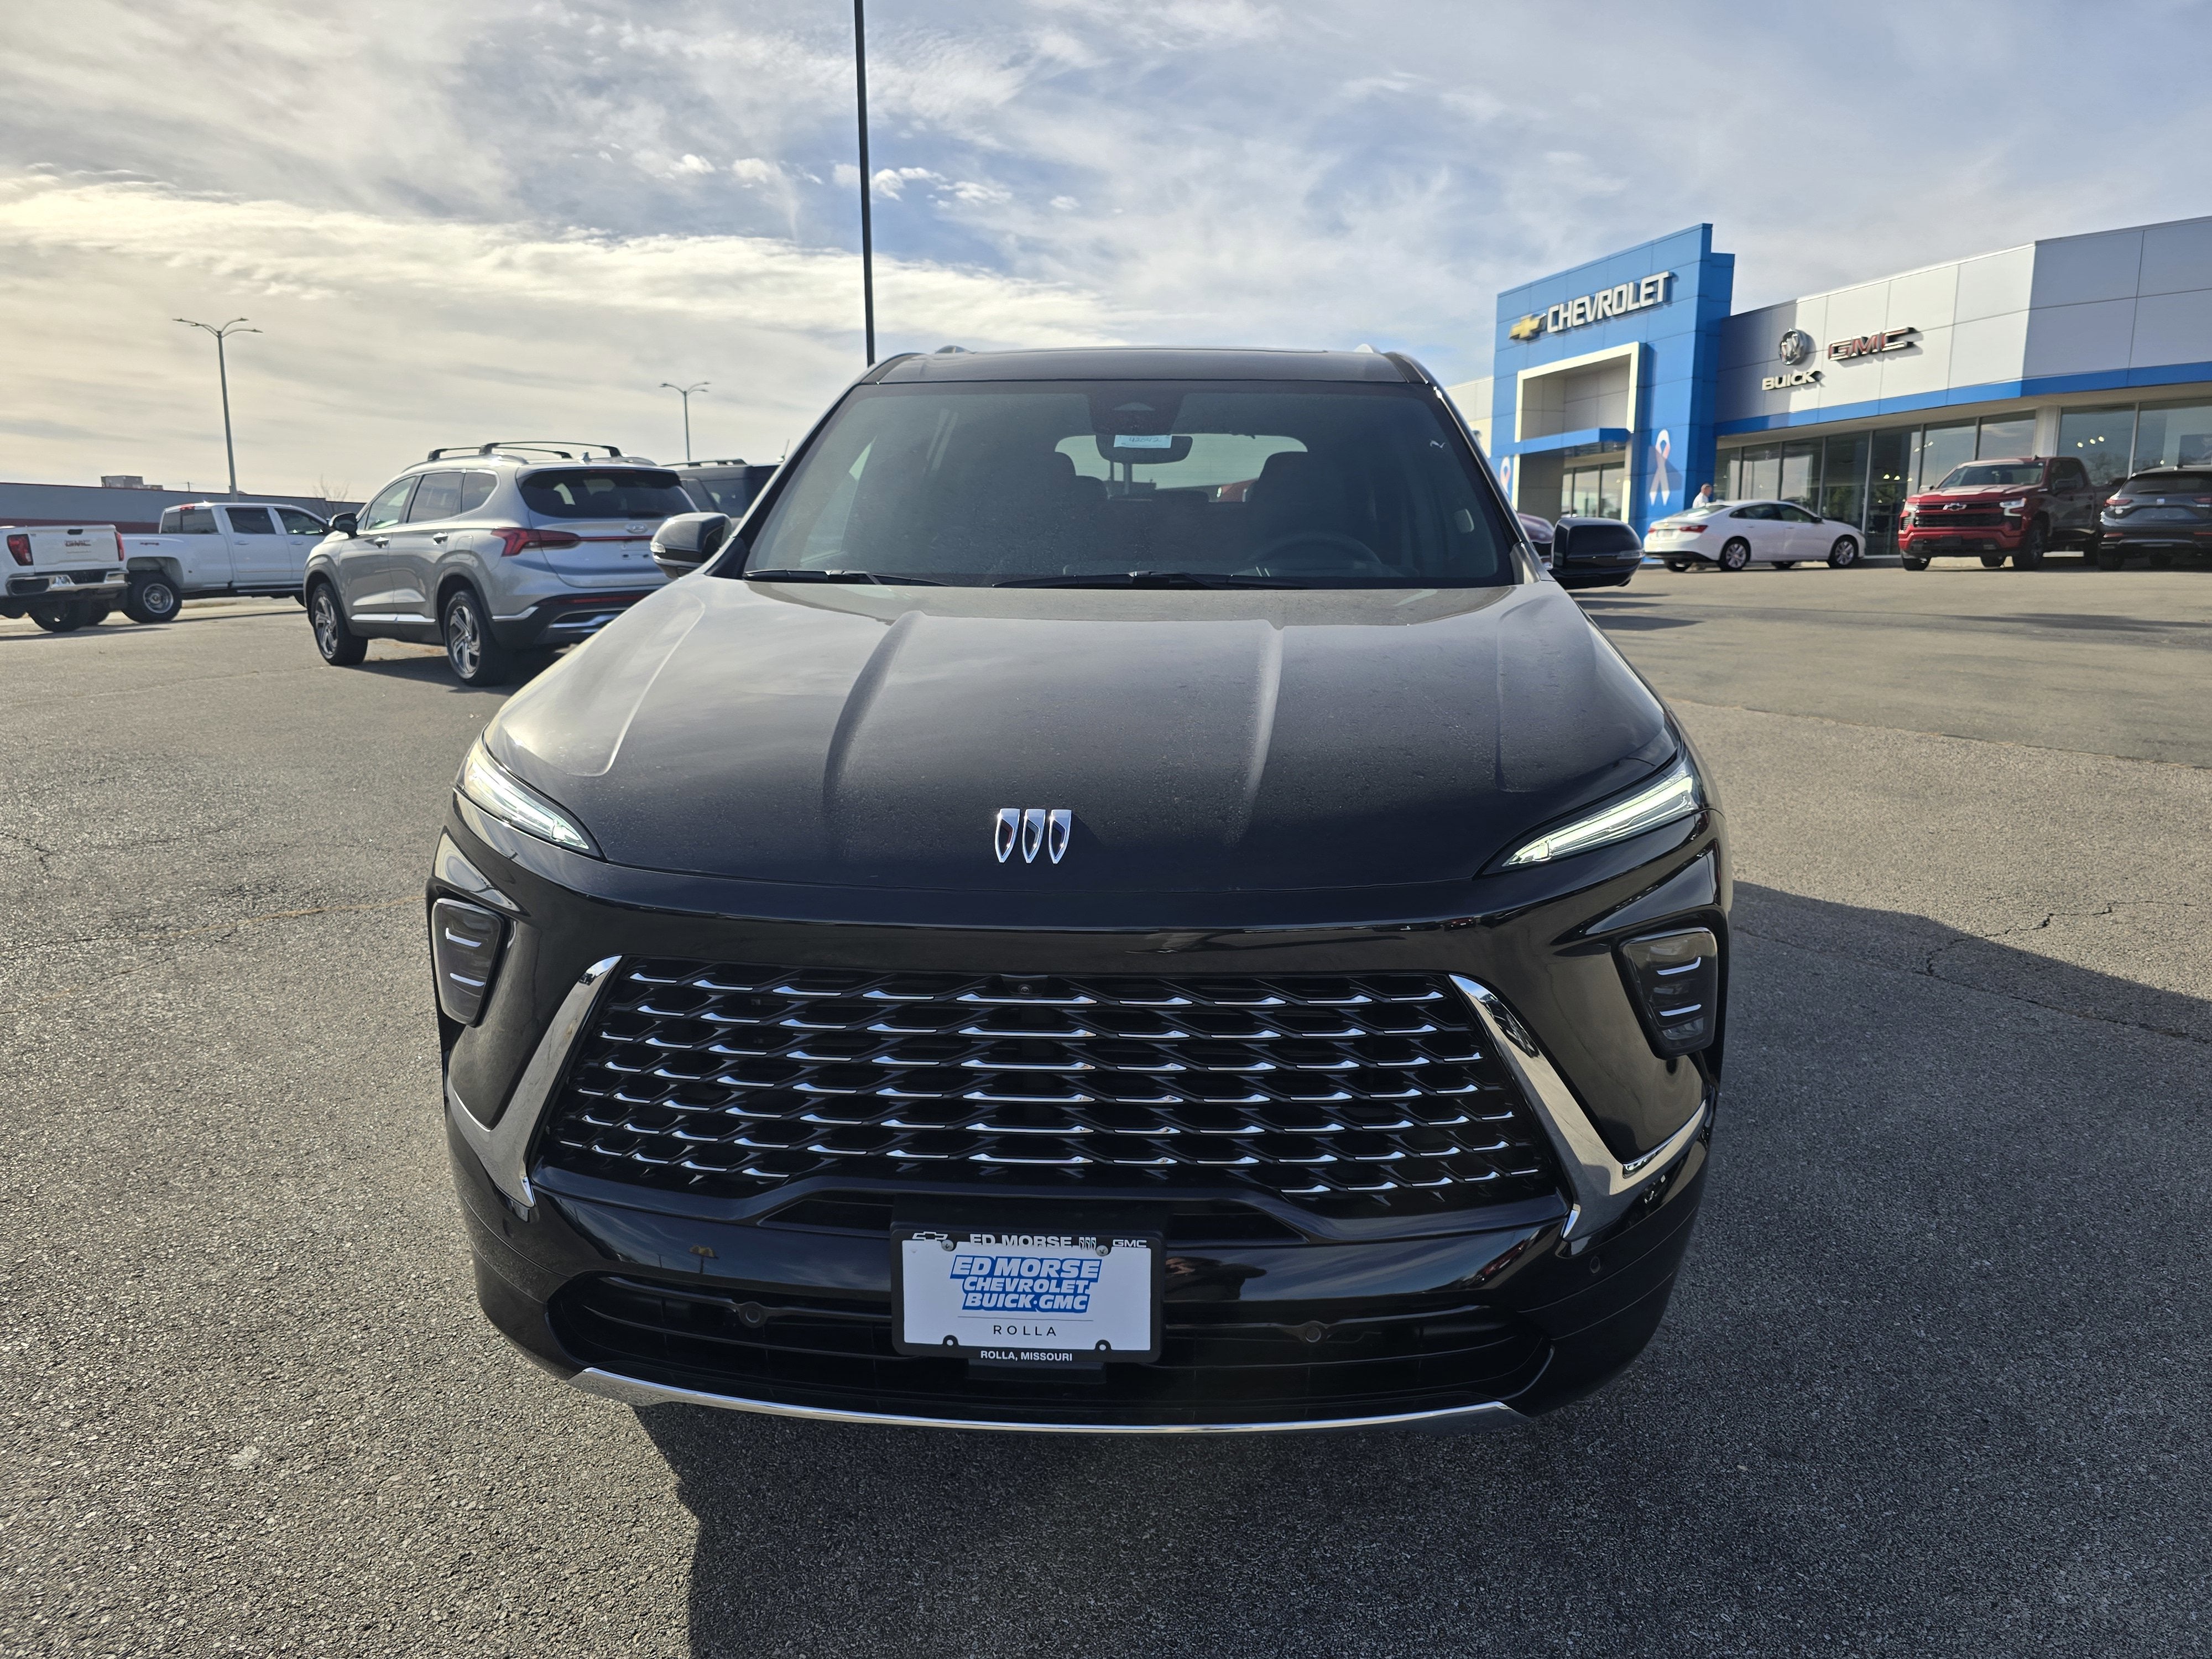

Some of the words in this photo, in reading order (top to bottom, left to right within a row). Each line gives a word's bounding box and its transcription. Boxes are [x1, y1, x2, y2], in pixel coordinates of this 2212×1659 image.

[1547, 272, 1671, 333] CHEVROLET
[1828, 327, 1911, 361] GMC
[1762, 371, 1816, 390] BUICK
[970, 1234, 995, 1245] ED
[1001, 1235, 1072, 1248] MORSE
[1113, 1239, 1147, 1248] GMC
[953, 1257, 992, 1275] ED
[994, 1258, 1100, 1278] MORSE
[993, 1325, 1056, 1336] ROLLA
[980, 1350, 1018, 1361] ROLLA,
[1021, 1352, 1072, 1361] MISSOURI
